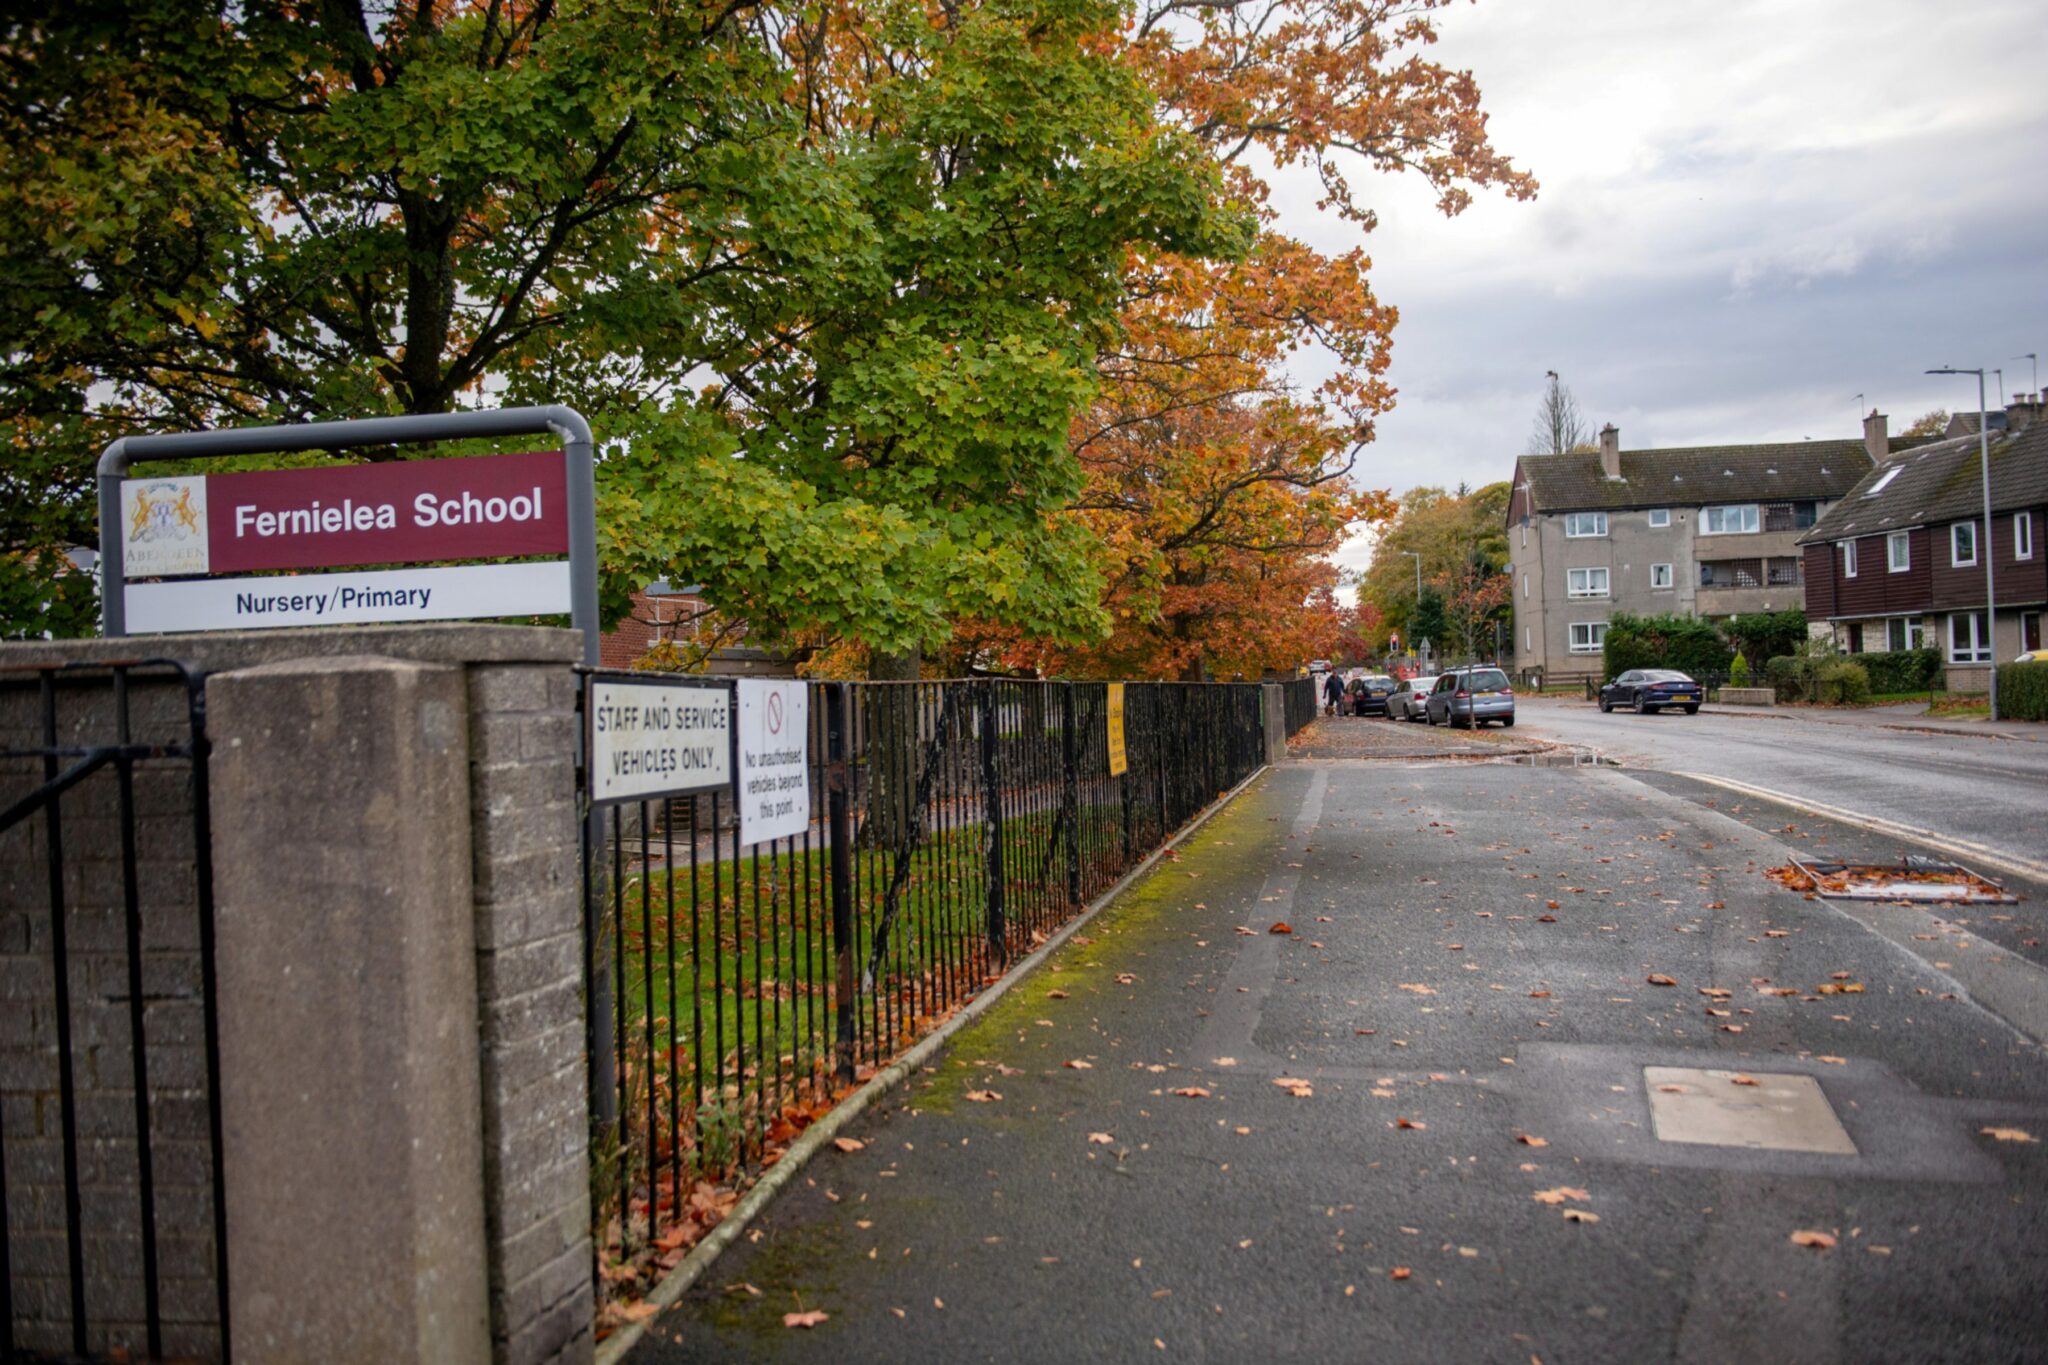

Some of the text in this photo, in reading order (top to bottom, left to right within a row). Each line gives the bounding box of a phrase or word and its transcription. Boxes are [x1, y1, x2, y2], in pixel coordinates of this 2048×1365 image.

[235, 487, 543, 538] Fernielea School
[126, 547, 205, 562] ABEEEN
[236, 586, 432, 615] Nursery/Primary
[597, 706, 726, 731] STAFF AND SERVICE
[613, 746, 714, 776] VEHICLES ONLY
[746, 747, 802, 768] No unauthorised
[747, 772, 803, 795] vehicles beyond
[760, 797, 793, 820] this point
